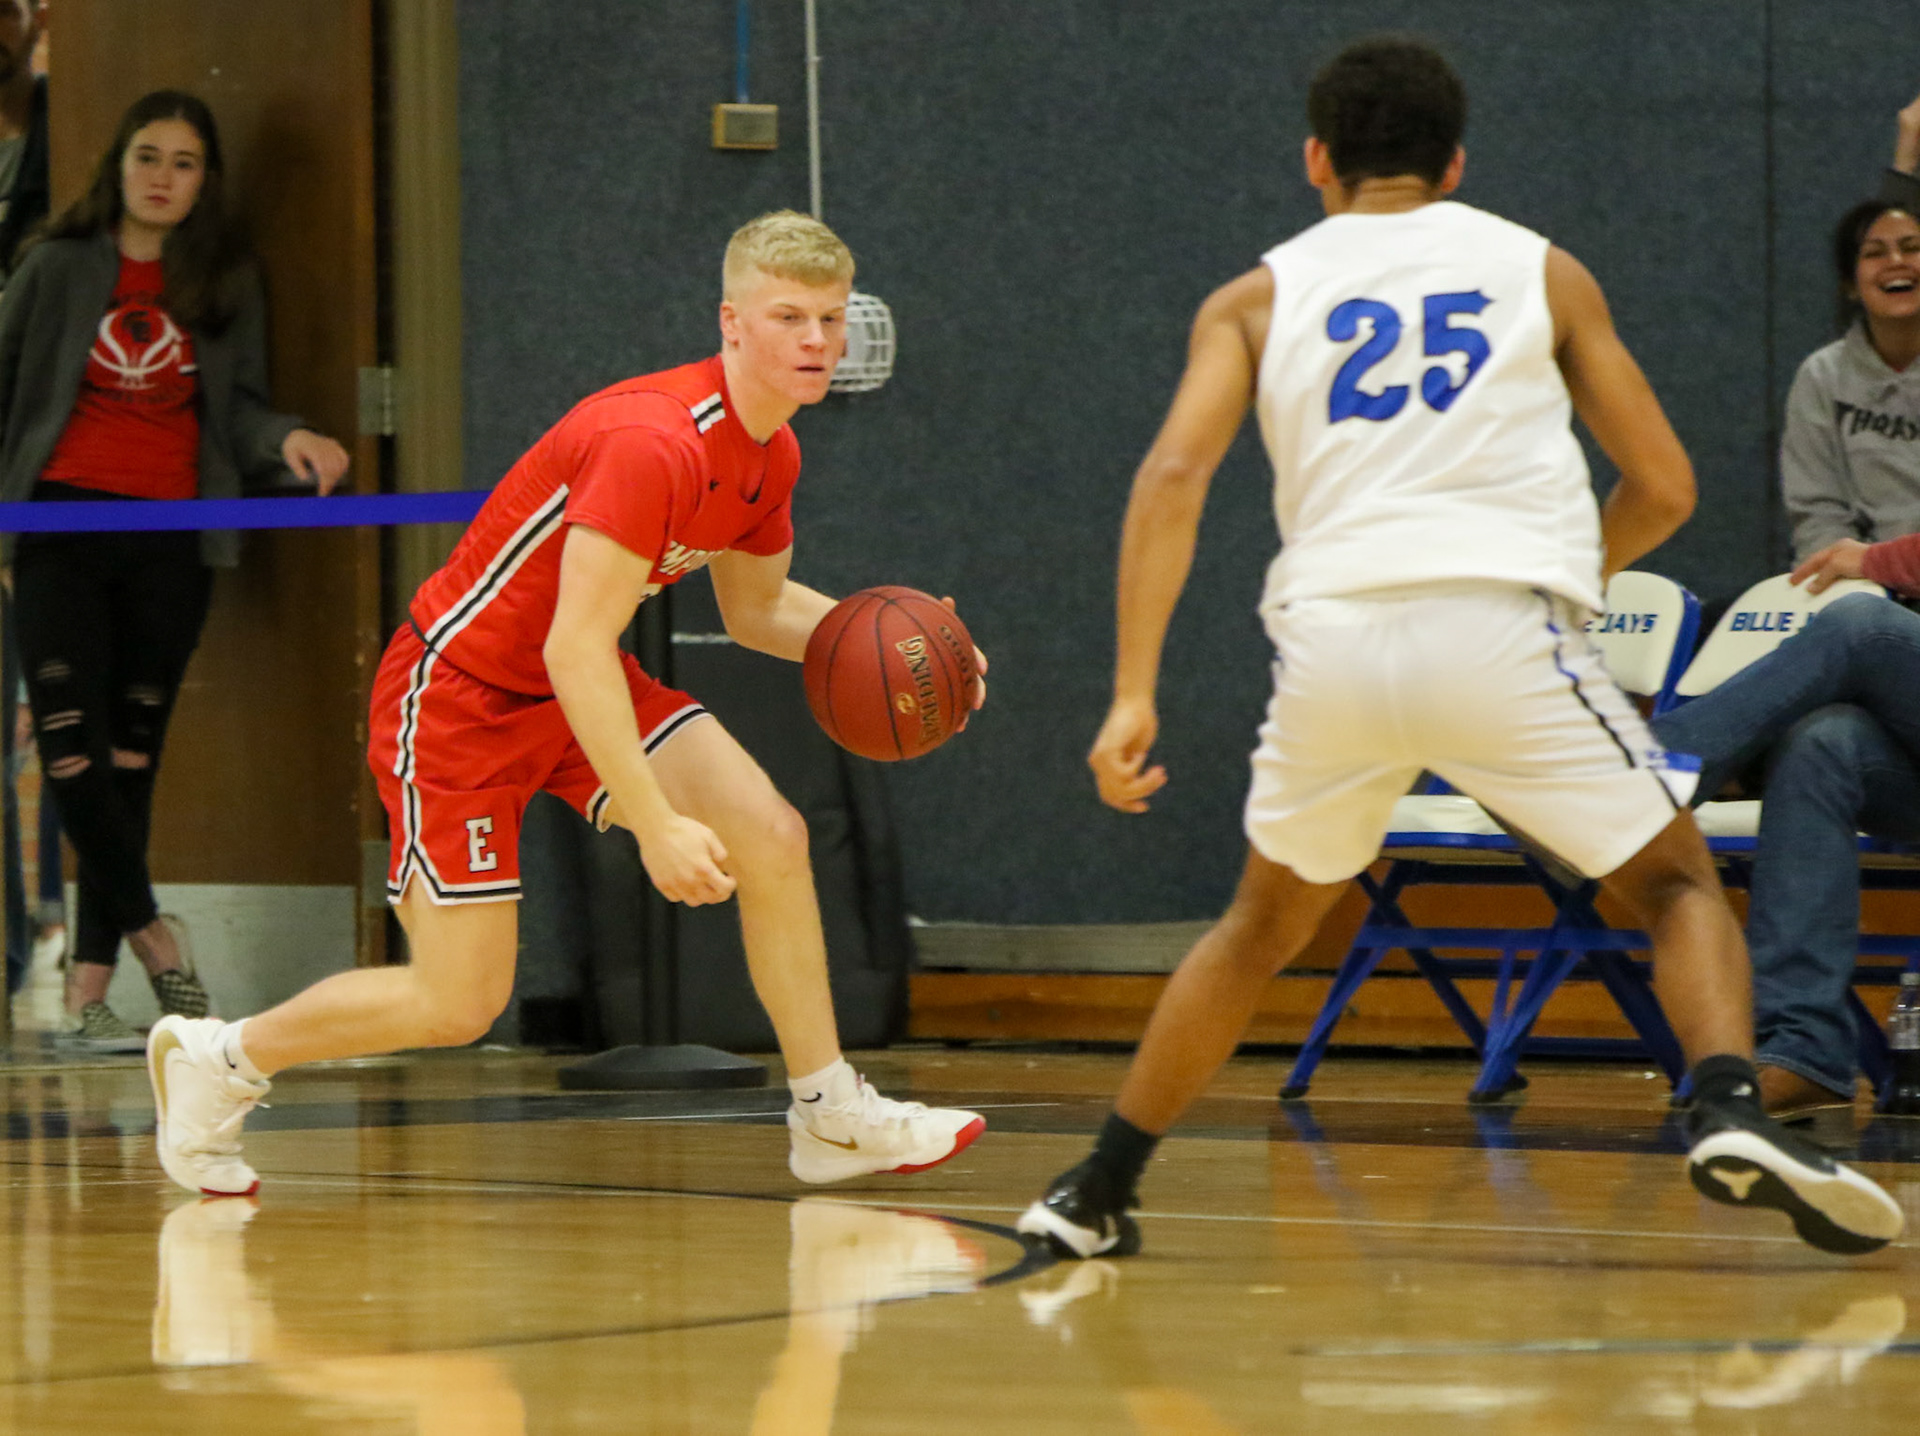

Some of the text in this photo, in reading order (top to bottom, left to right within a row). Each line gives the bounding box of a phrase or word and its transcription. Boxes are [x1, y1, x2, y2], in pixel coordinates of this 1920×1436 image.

[1325, 290, 1496, 425] 25
[1598, 613, 1658, 633] JAYS
[1730, 612, 1794, 632] BLUE
[465, 815, 498, 874] E
